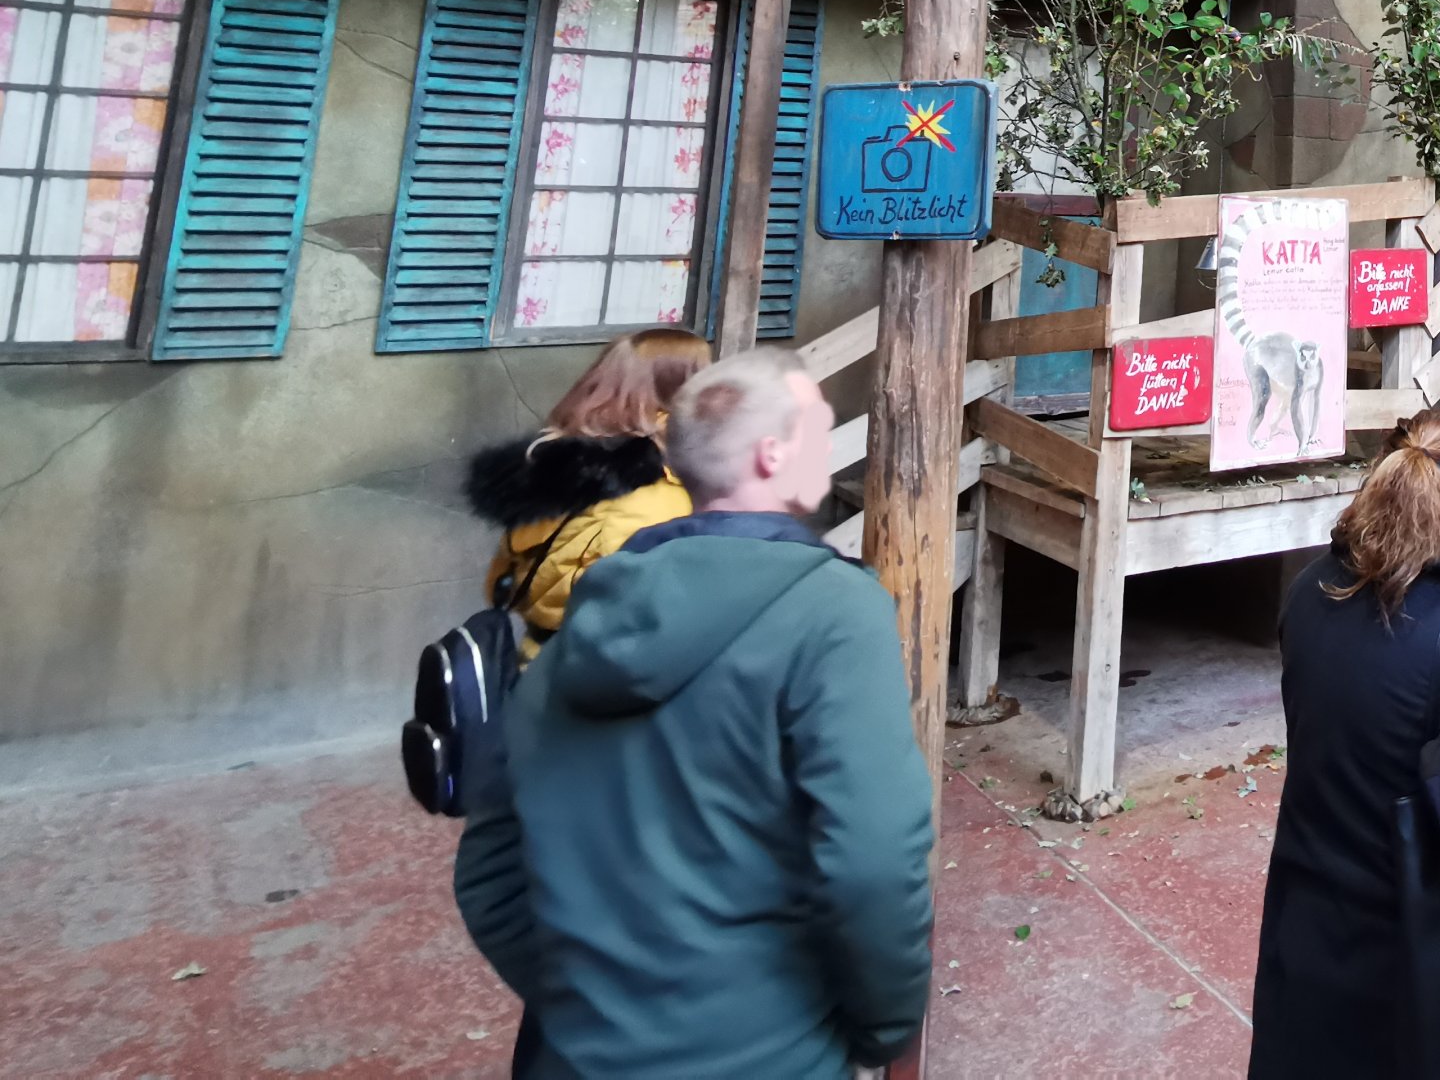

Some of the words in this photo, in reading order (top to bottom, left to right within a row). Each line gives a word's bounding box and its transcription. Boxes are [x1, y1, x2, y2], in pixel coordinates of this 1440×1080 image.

[836, 196, 874, 225] Kein
[879, 194, 968, 224] Blitzlicht
[1263, 240, 1321, 265] KATTA
[1358, 261, 1386, 283] Bitte
[1390, 263, 1415, 279] nicht
[1370, 296, 1411, 315] DANKE
[1126, 353, 1157, 376] Bitte
[1162, 353, 1193, 369] nicht
[1135, 391, 1184, 415] DANKE
